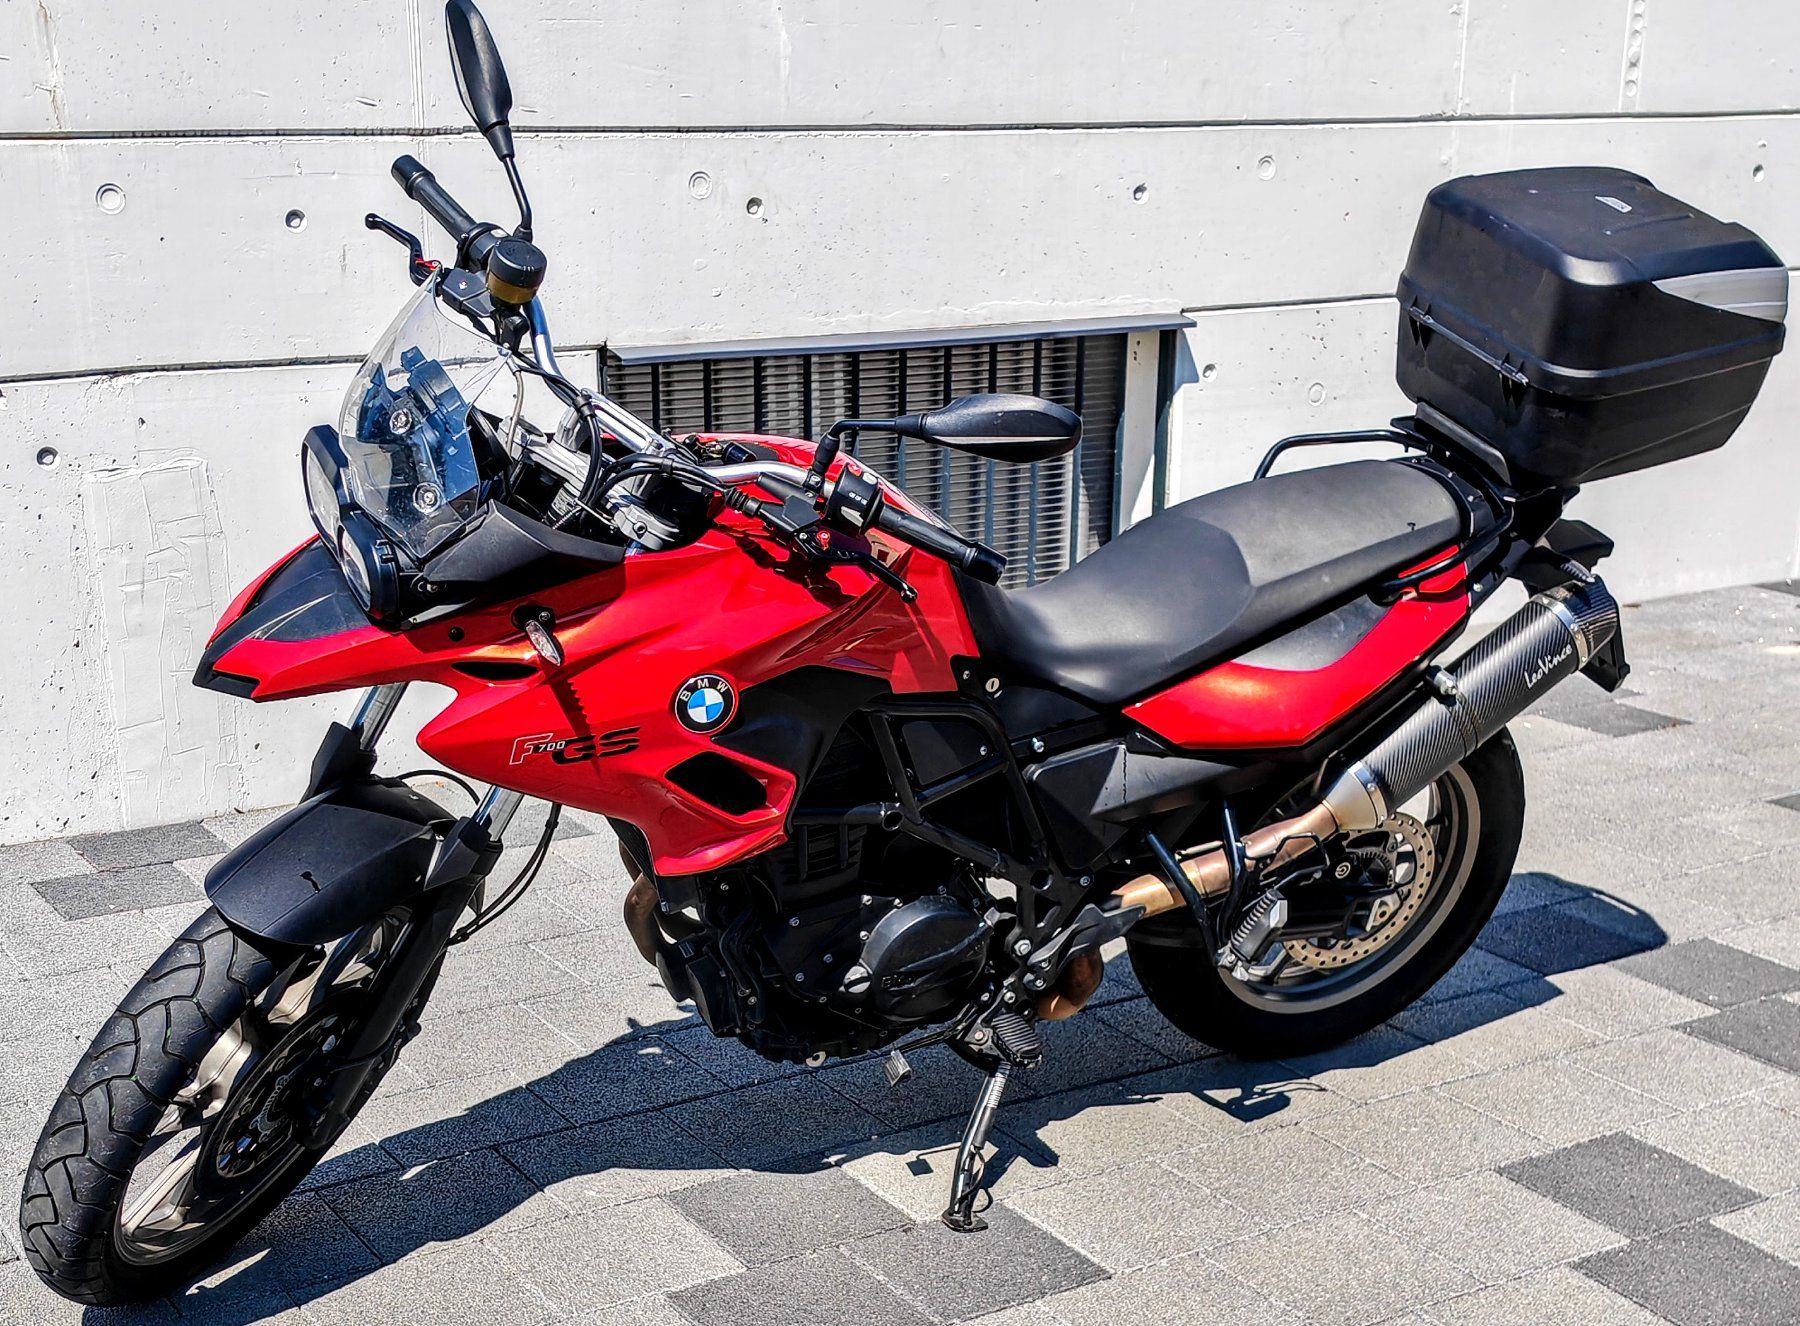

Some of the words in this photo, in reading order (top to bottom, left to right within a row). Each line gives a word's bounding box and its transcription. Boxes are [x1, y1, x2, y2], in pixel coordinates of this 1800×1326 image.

[1523, 643, 1573, 689] LeoVince
[680, 678, 729, 702] BMW
[509, 733, 554, 765] F
[537, 741, 566, 753] 700
[551, 726, 641, 765] GS
